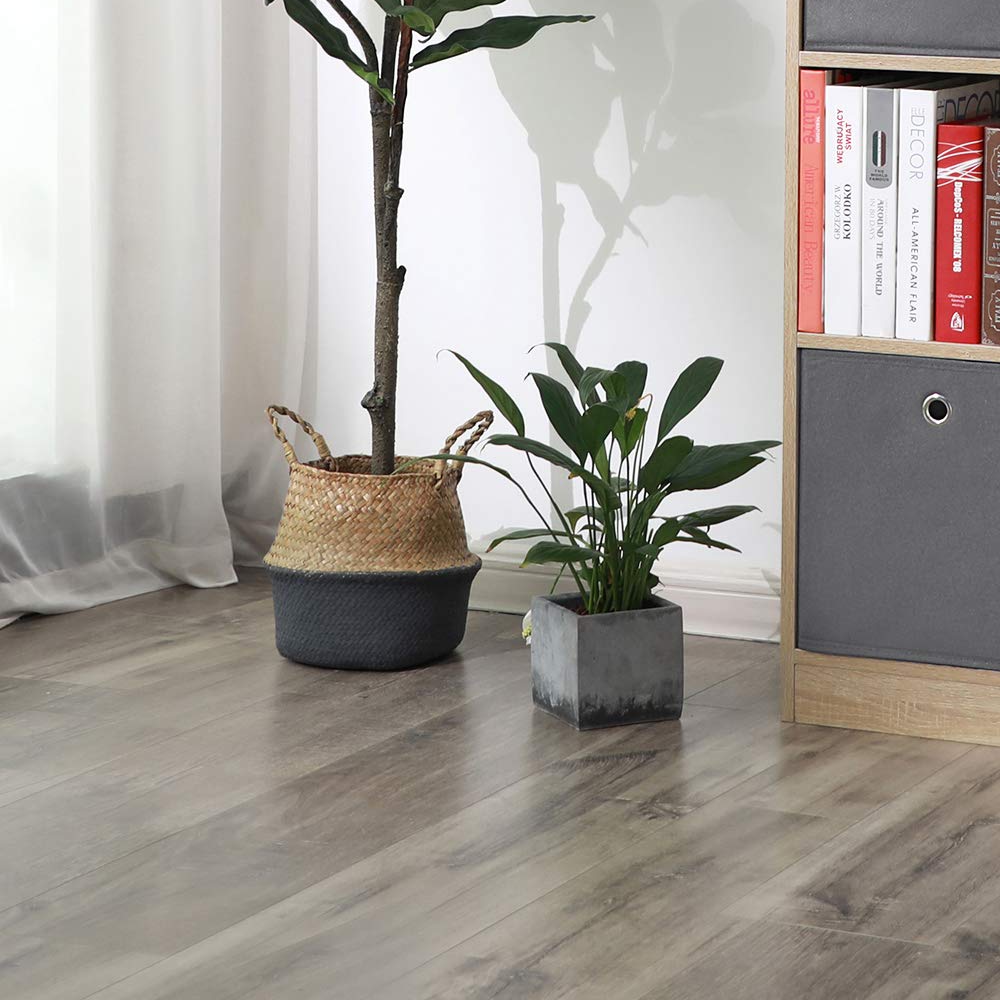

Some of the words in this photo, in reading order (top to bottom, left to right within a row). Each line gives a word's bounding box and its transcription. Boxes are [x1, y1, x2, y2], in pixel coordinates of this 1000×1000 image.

[803, 89, 820, 144] allure
[909, 115, 925, 180] DECOR
[803, 164, 819, 233] American
[876, 198, 884, 238] AROUND
[803, 240, 818, 293] Beauty
[876, 242, 884, 259] THE
[909, 207, 919, 289] ALL-AMERICAN
[875, 263, 883, 296] WORLD
[909, 294, 917, 323] FLAIR
